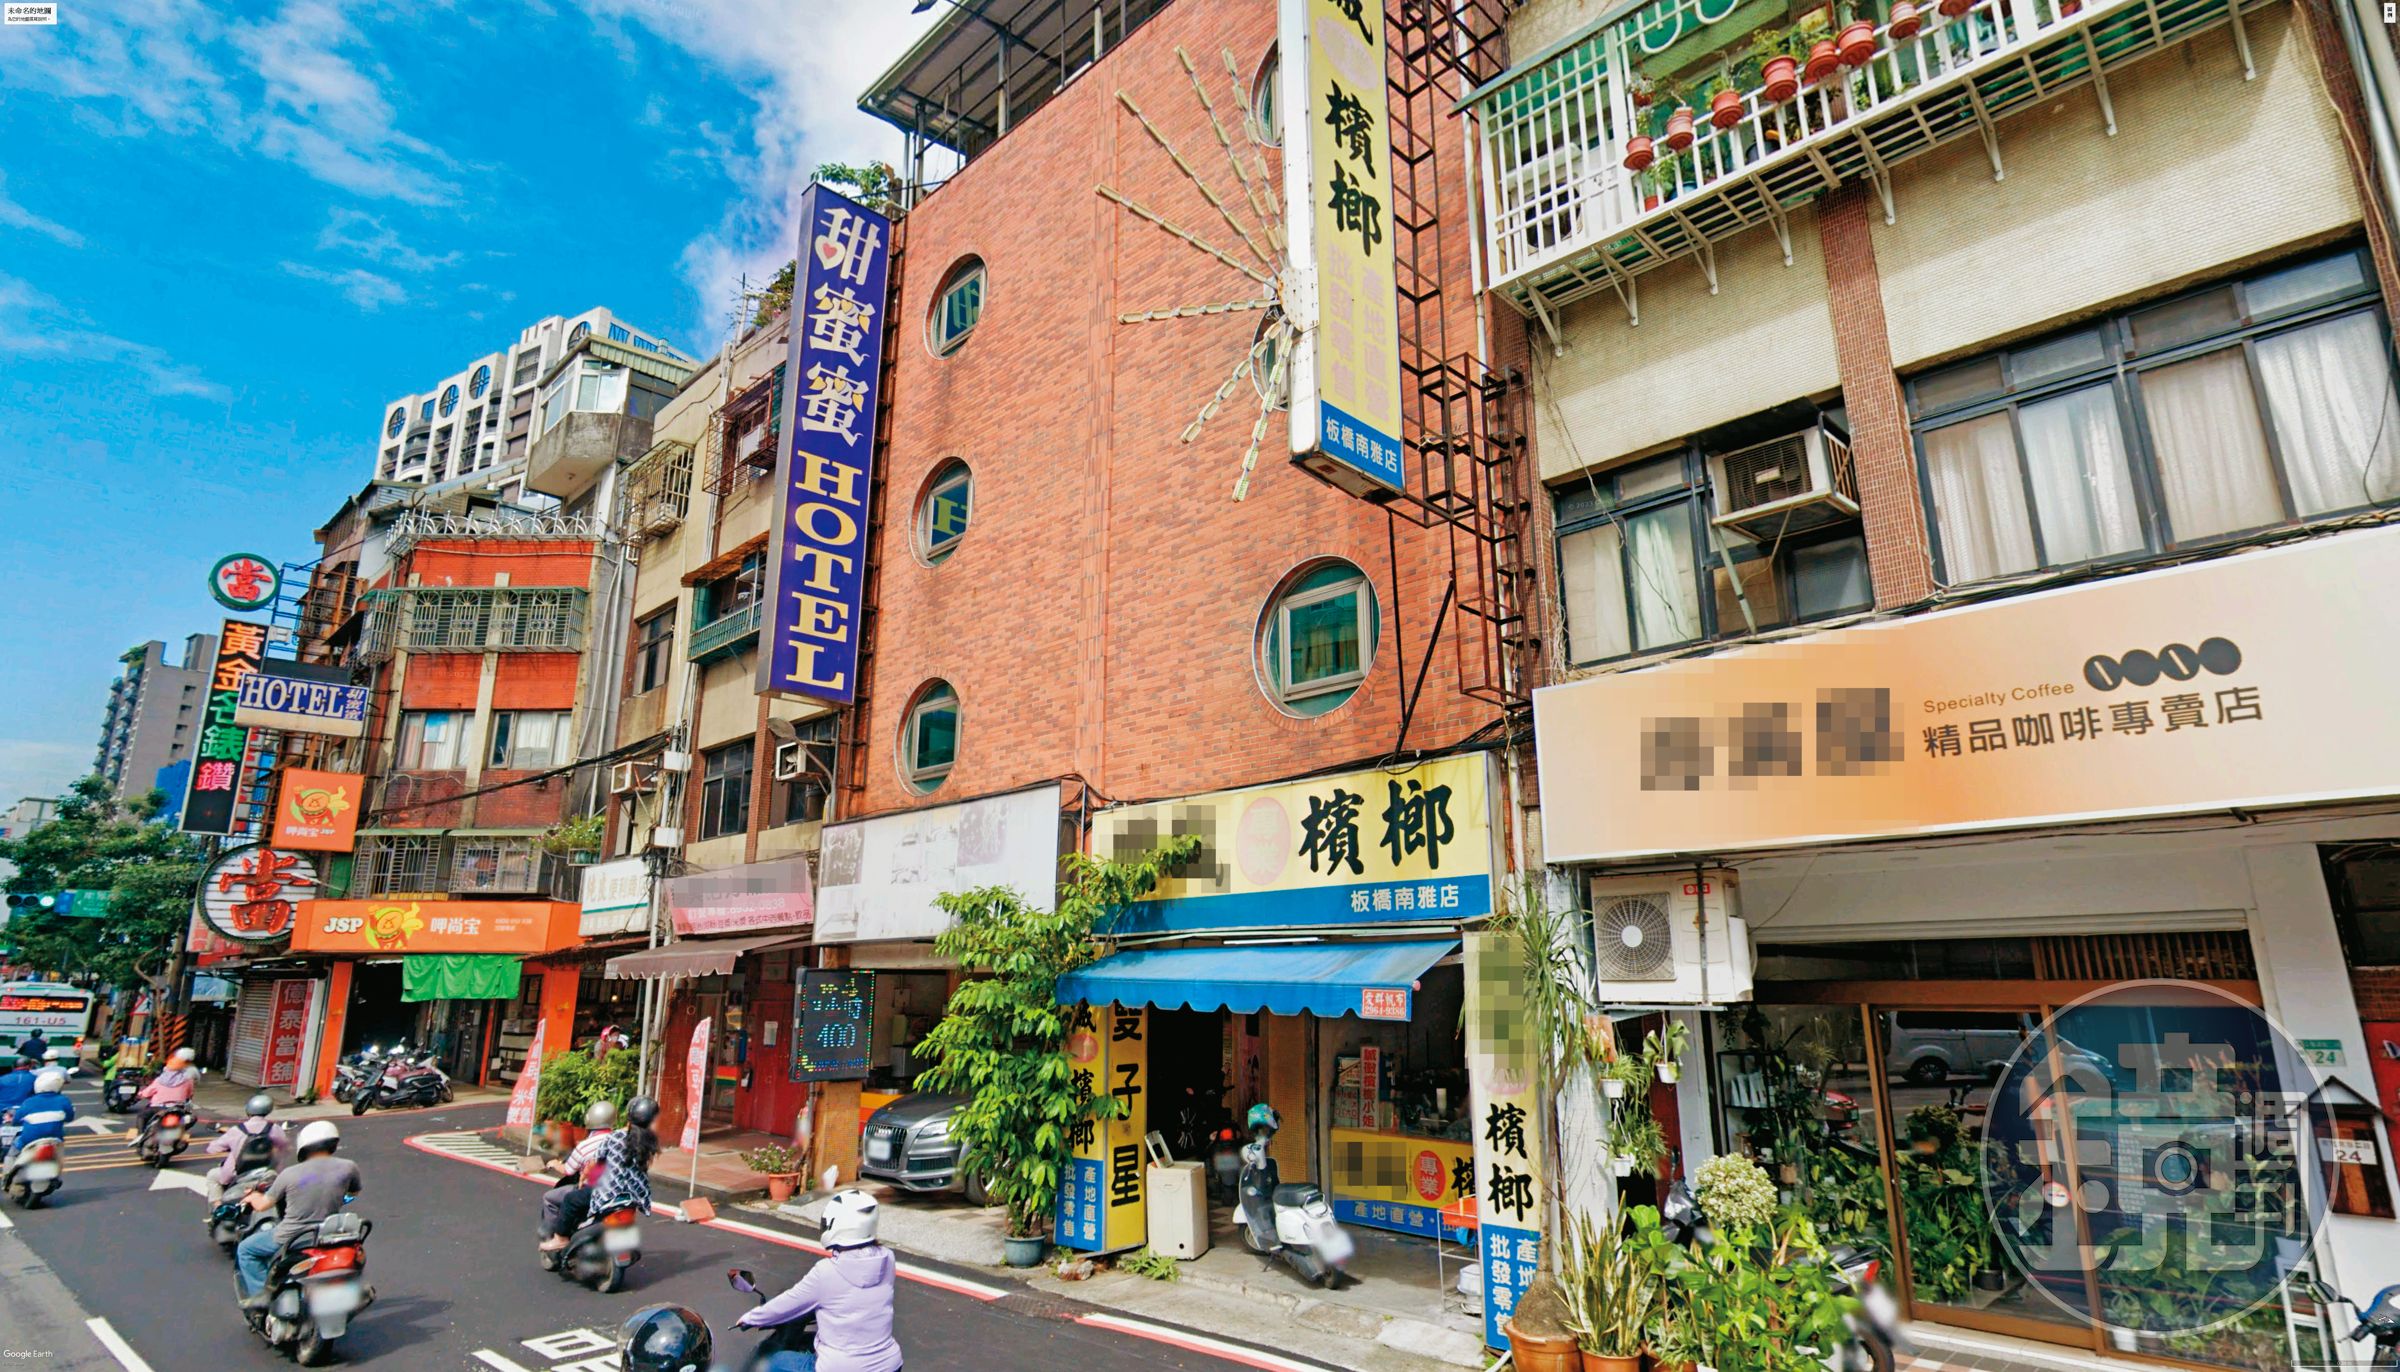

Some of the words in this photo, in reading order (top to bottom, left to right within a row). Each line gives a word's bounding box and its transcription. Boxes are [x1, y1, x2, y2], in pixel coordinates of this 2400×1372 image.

[1324, 80, 1382, 257] 檳榔
[801, 206, 881, 447] 甜蜜蜜
[1325, 418, 1398, 474] 板橋南雅店
[222, 558, 273, 601] 當
[785, 450, 863, 690] HOTEL
[241, 674, 344, 718] HOTEL
[1923, 693, 2006, 714] Specialty
[2012, 682, 2075, 701] Coffee
[1922, 686, 2263, 759] 精品咖啡專賣店
[1299, 779, 1455, 877] 檳榔
[219, 847, 312, 933] 當
[1351, 884, 1459, 913] 板橋南雅店
[323, 917, 363, 934] JSP
[430, 917, 481, 935] 呷尚宝
[2316, 1051, 2336, 1064] 24
[1485, 1102, 1534, 1222] 檳榔
[2336, 1149, 2362, 1161] 24
[1084, 1166, 1096, 1241] 產地直營
[1354, 1201, 1425, 1228] 產地直營
